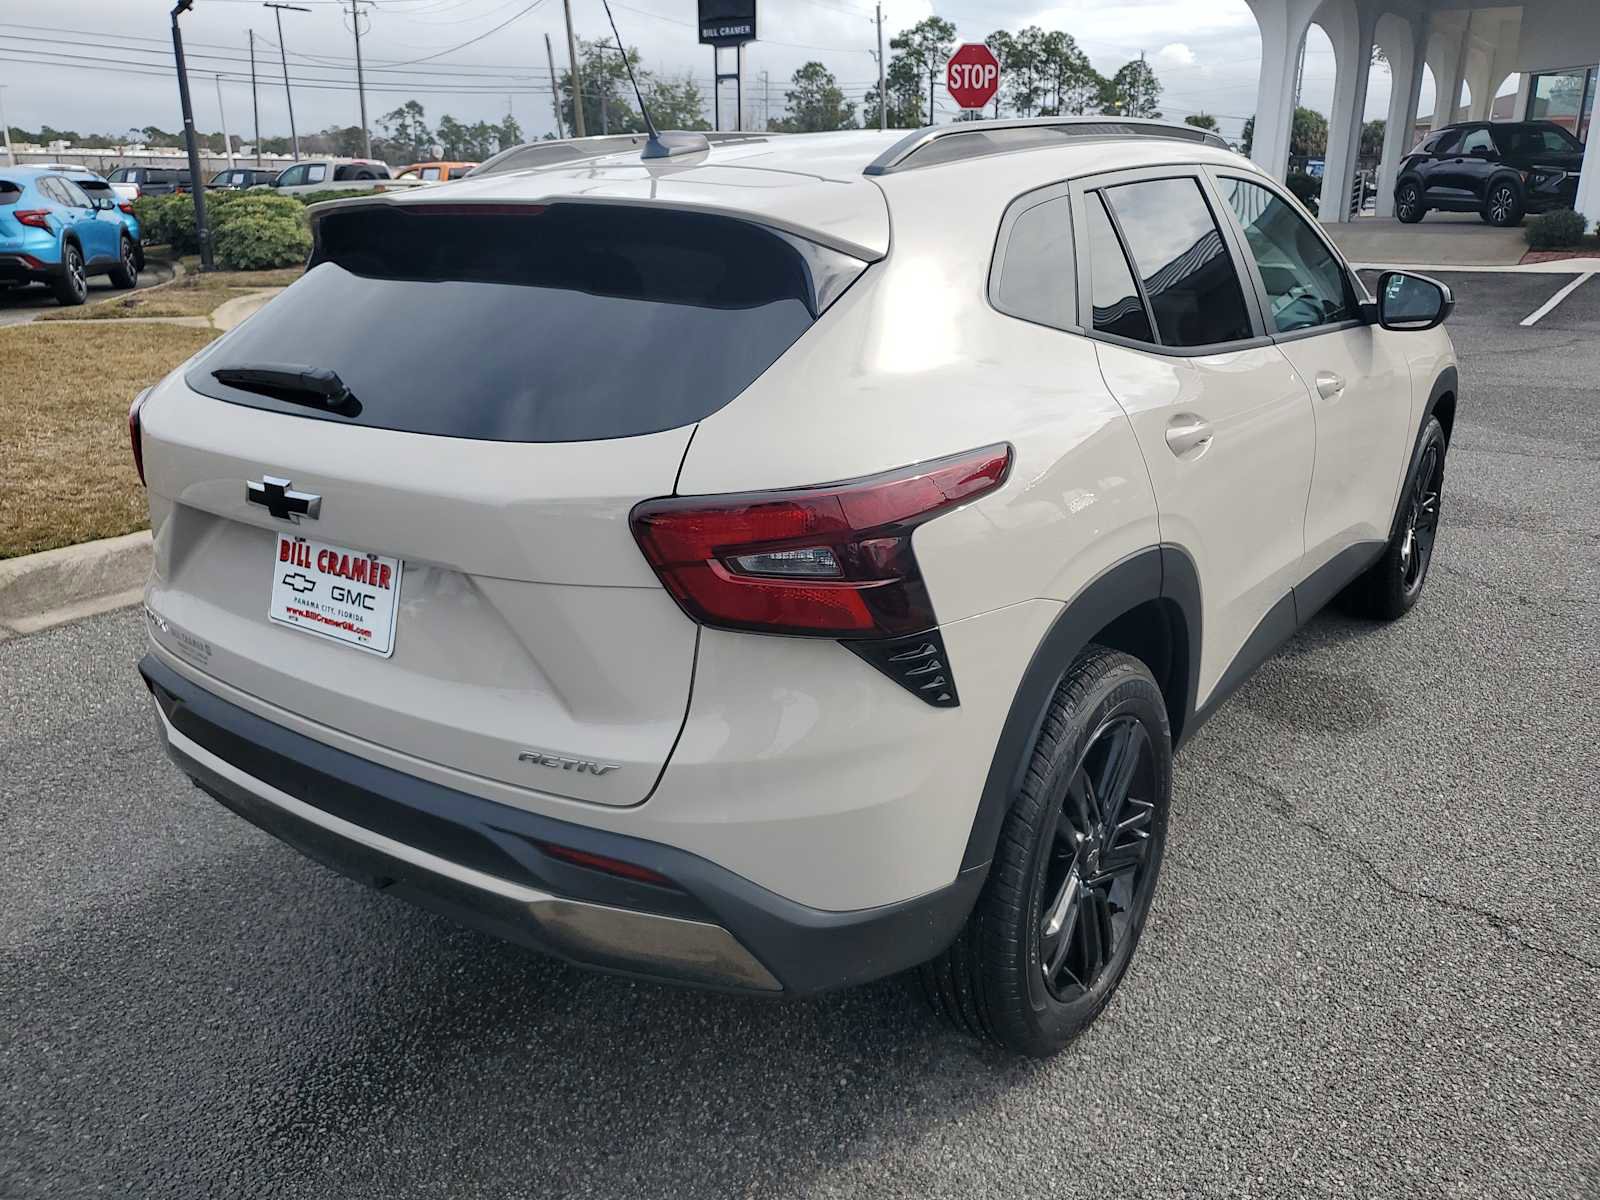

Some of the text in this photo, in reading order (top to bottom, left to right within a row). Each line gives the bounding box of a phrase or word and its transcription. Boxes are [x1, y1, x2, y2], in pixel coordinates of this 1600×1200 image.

[702, 25, 751, 38] BILL CRAMER
[949, 63, 996, 89] STOP
[279, 539, 392, 590] BILL CRAMER
[294, 596, 320, 610] PANAMA
[338, 609, 364, 623] FLORIDA
[331, 585, 376, 611] GMC
[519, 750, 620, 776] ACTIV
